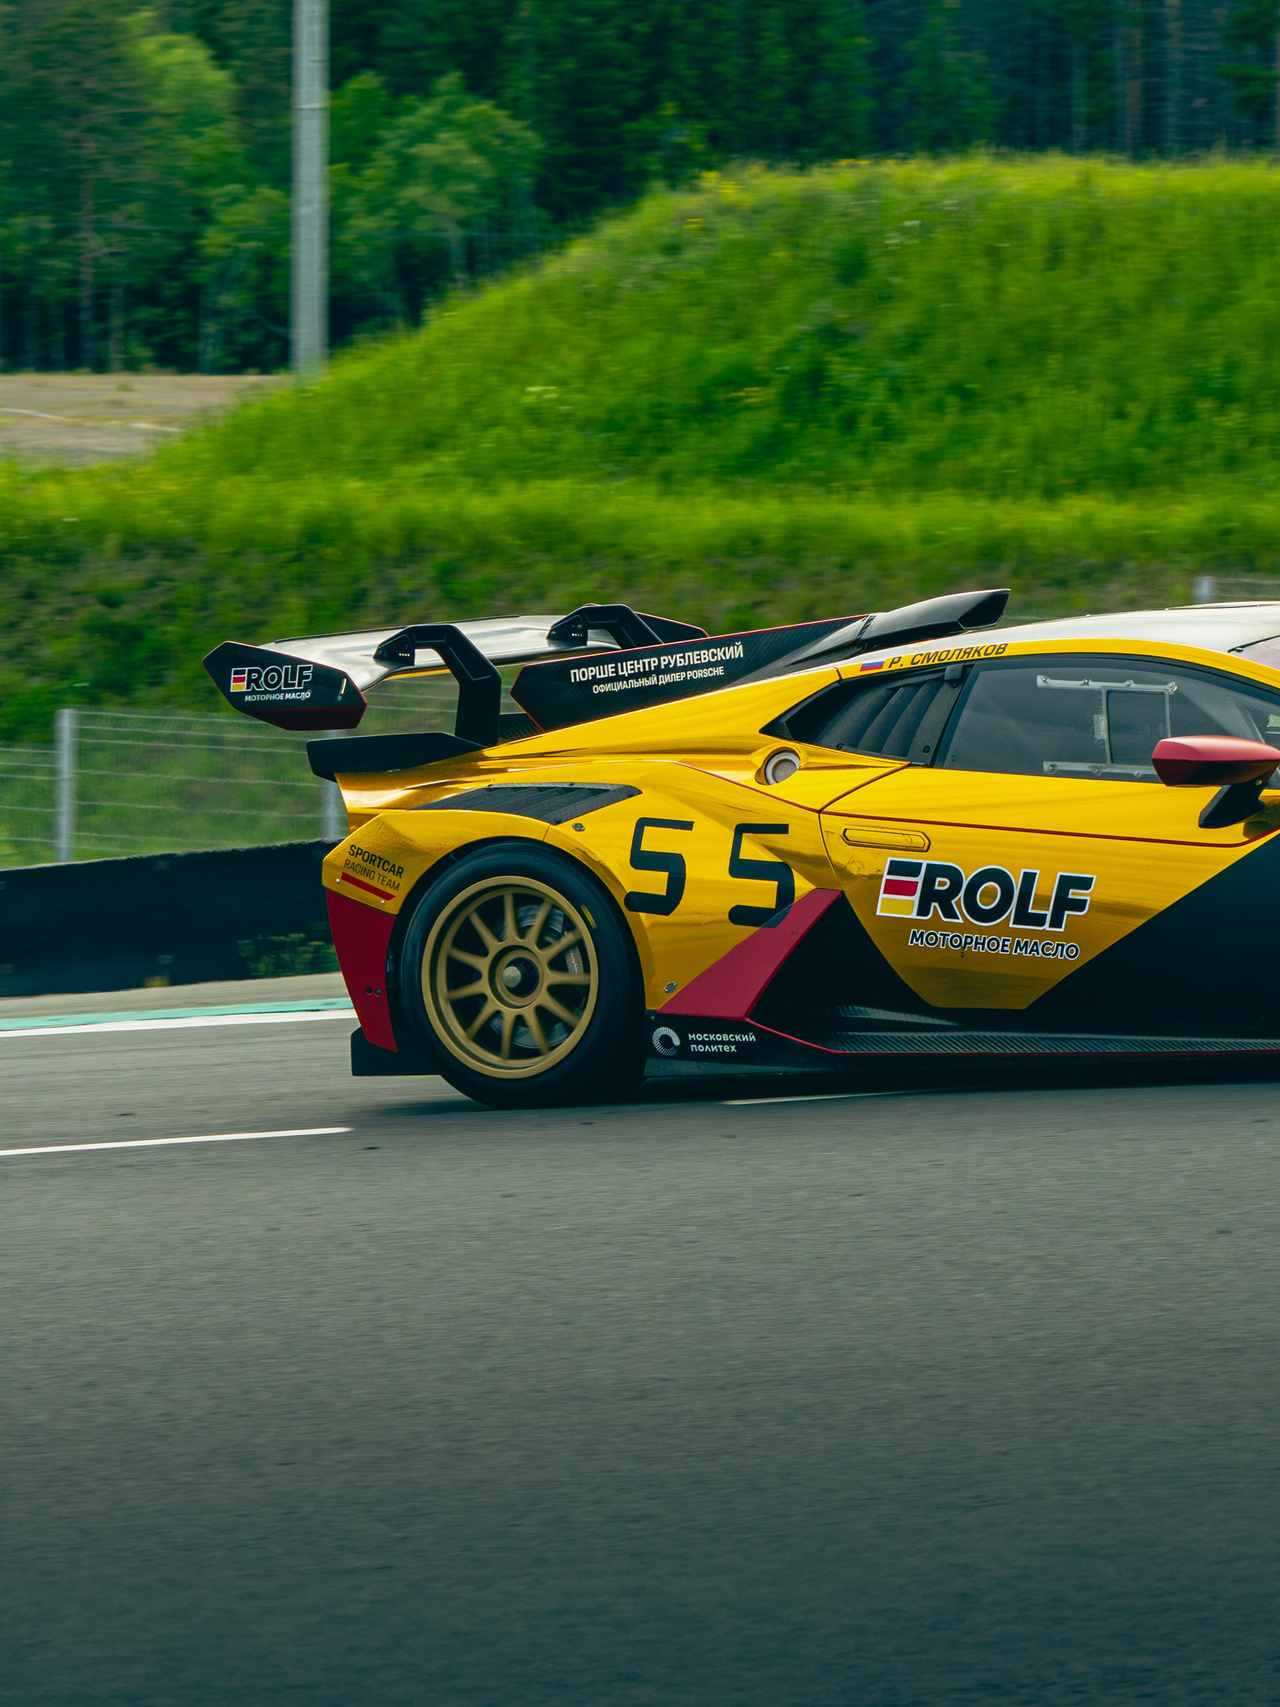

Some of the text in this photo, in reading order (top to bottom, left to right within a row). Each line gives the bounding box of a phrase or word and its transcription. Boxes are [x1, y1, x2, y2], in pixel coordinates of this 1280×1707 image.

[570, 641, 744, 683] ПОРШЕ ЦЕНТР РУБЛЕВСКИЙ
[888, 643, 1009, 668] Р. СМОЛЯКОВ
[245, 664, 313, 692] ROLF
[592, 665, 725, 694] ОФИЦИАЛЬНЫЙ ДИЛЕР PORSCHE
[244, 690, 311, 702] МОТОРНОЕ МАСЛО
[344, 858, 401, 892] RACING TEAM
[348, 844, 405, 879] SPORTCAR
[913, 860, 1097, 932] ROLF
[908, 929, 1081, 962] МОТОРНОЕ МАСЛО
